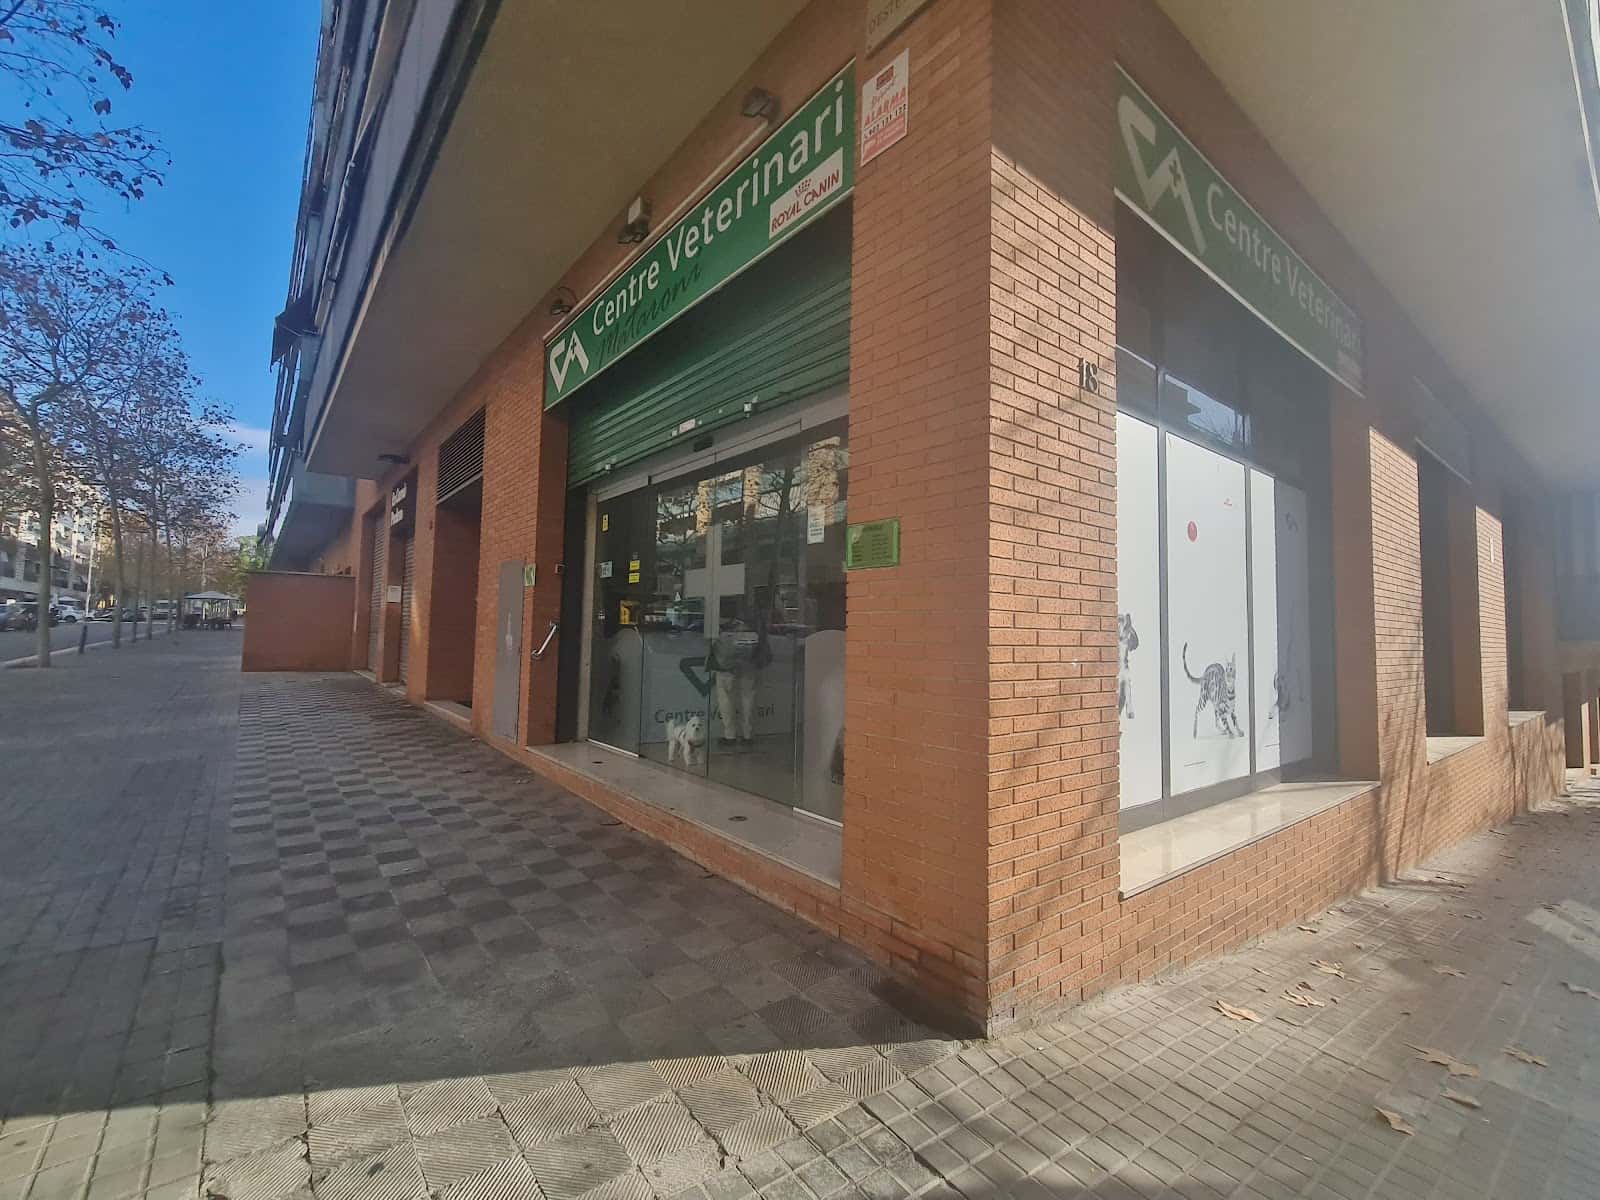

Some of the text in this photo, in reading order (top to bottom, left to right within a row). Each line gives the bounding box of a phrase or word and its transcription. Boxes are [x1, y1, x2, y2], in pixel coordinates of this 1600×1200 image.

[593, 79, 844, 335] Centre Veterinari
[771, 169, 840, 233] ROYAL CANIN
[1206, 182, 1281, 285] Centre
[1077, 357, 1097, 391] 18
